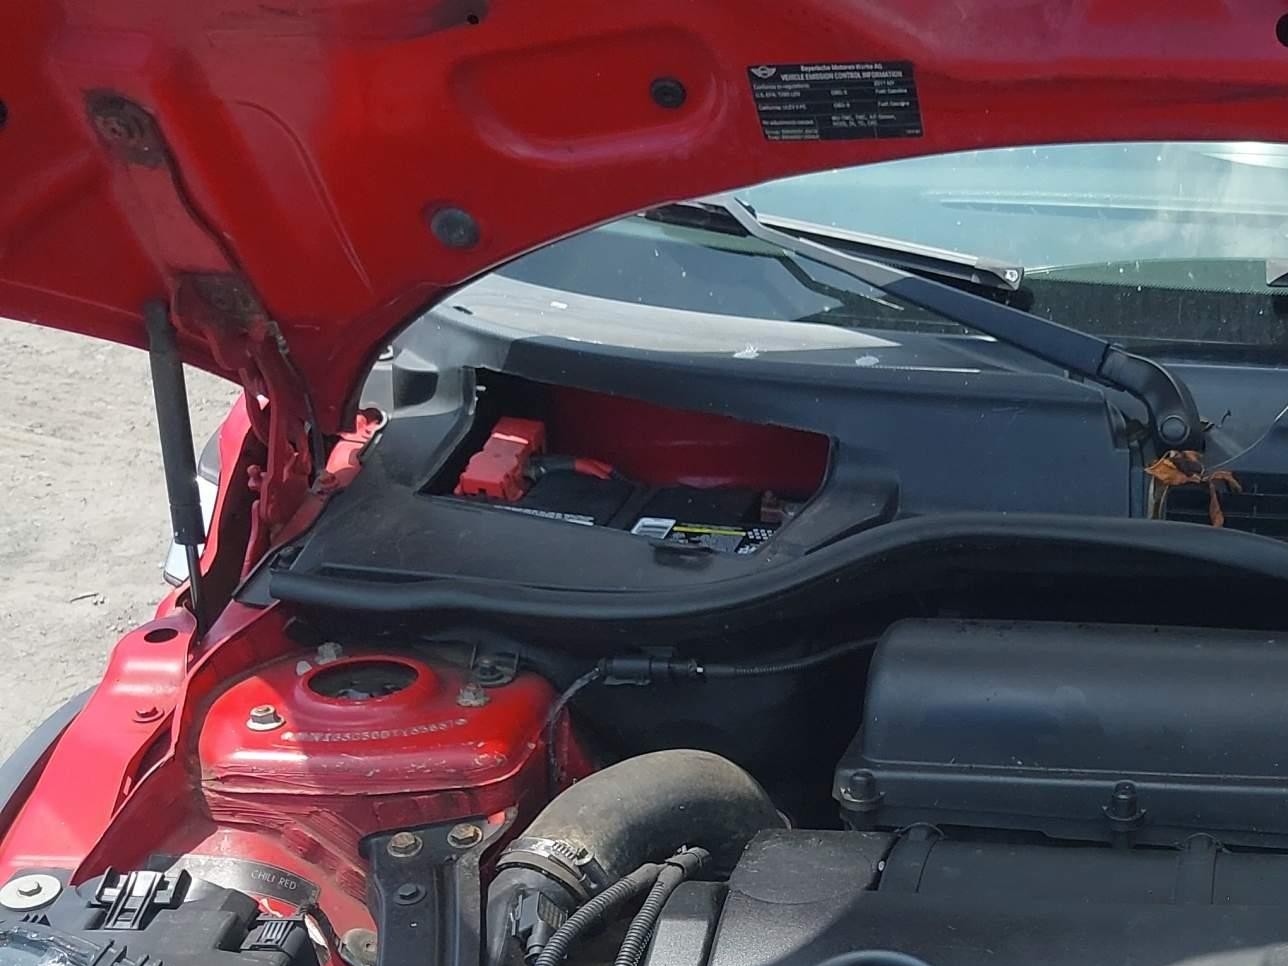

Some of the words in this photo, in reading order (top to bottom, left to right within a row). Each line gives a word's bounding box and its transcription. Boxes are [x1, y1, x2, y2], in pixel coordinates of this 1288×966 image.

[781, 73, 804, 81] VEHICLE
[806, 72, 833, 80] EMISSION
[834, 72, 861, 80] CONTROL
[251, 870, 276, 883] CHILI
[278, 877, 297, 890] RED
